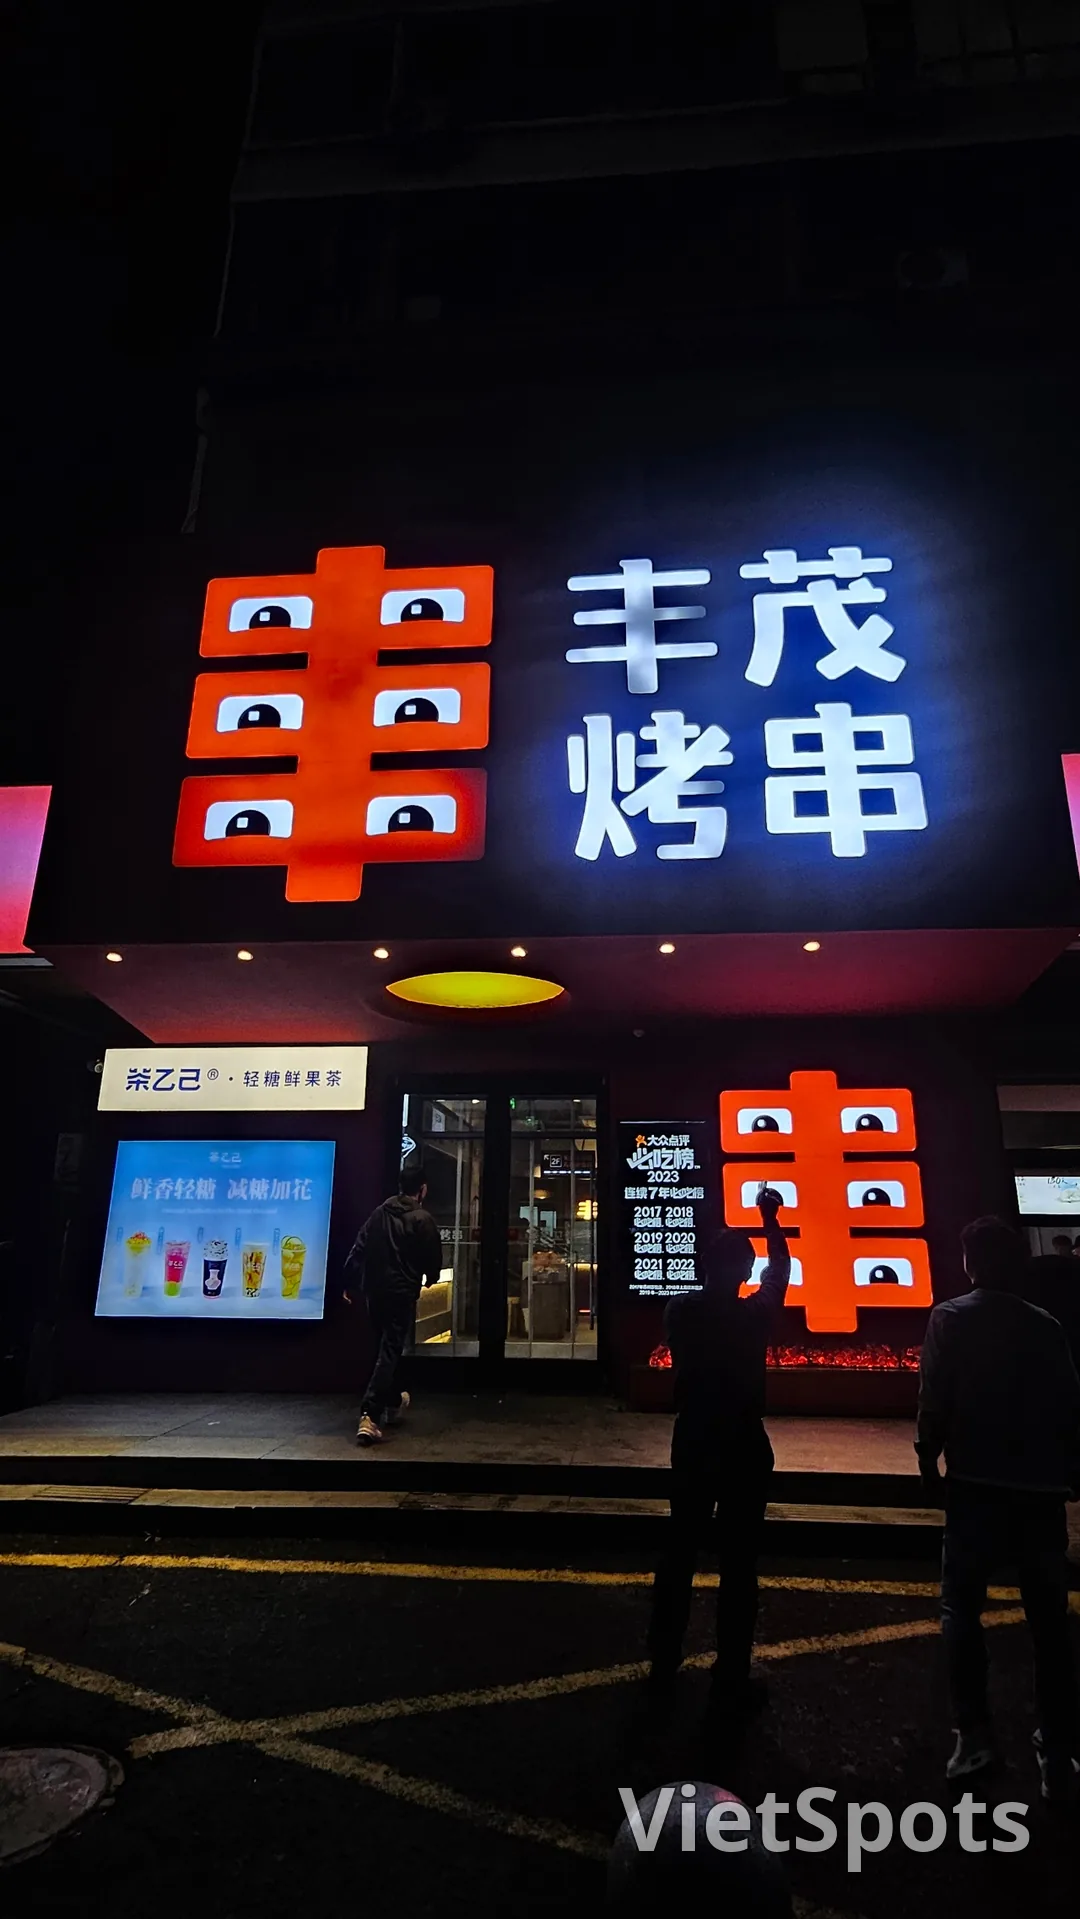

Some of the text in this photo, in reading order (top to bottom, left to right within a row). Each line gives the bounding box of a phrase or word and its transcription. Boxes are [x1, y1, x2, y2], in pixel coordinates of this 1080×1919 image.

[566, 546, 907, 694] 丰茂
[566, 702, 929, 861] 烤串
[243, 1070, 342, 1087] 轻糖鲜果茶
[647, 1134, 690, 1146] 大众点评
[626, 1147, 694, 1169] 必吃榜
[647, 1171, 679, 1183] 2023
[131, 1178, 312, 1200] 鲜香轻糖 减糖加花
[634, 1206, 694, 1217] 2017 2018
[634, 1232, 696, 1243] 2019 2020
[634, 1258, 695, 1270] 2021 2022
